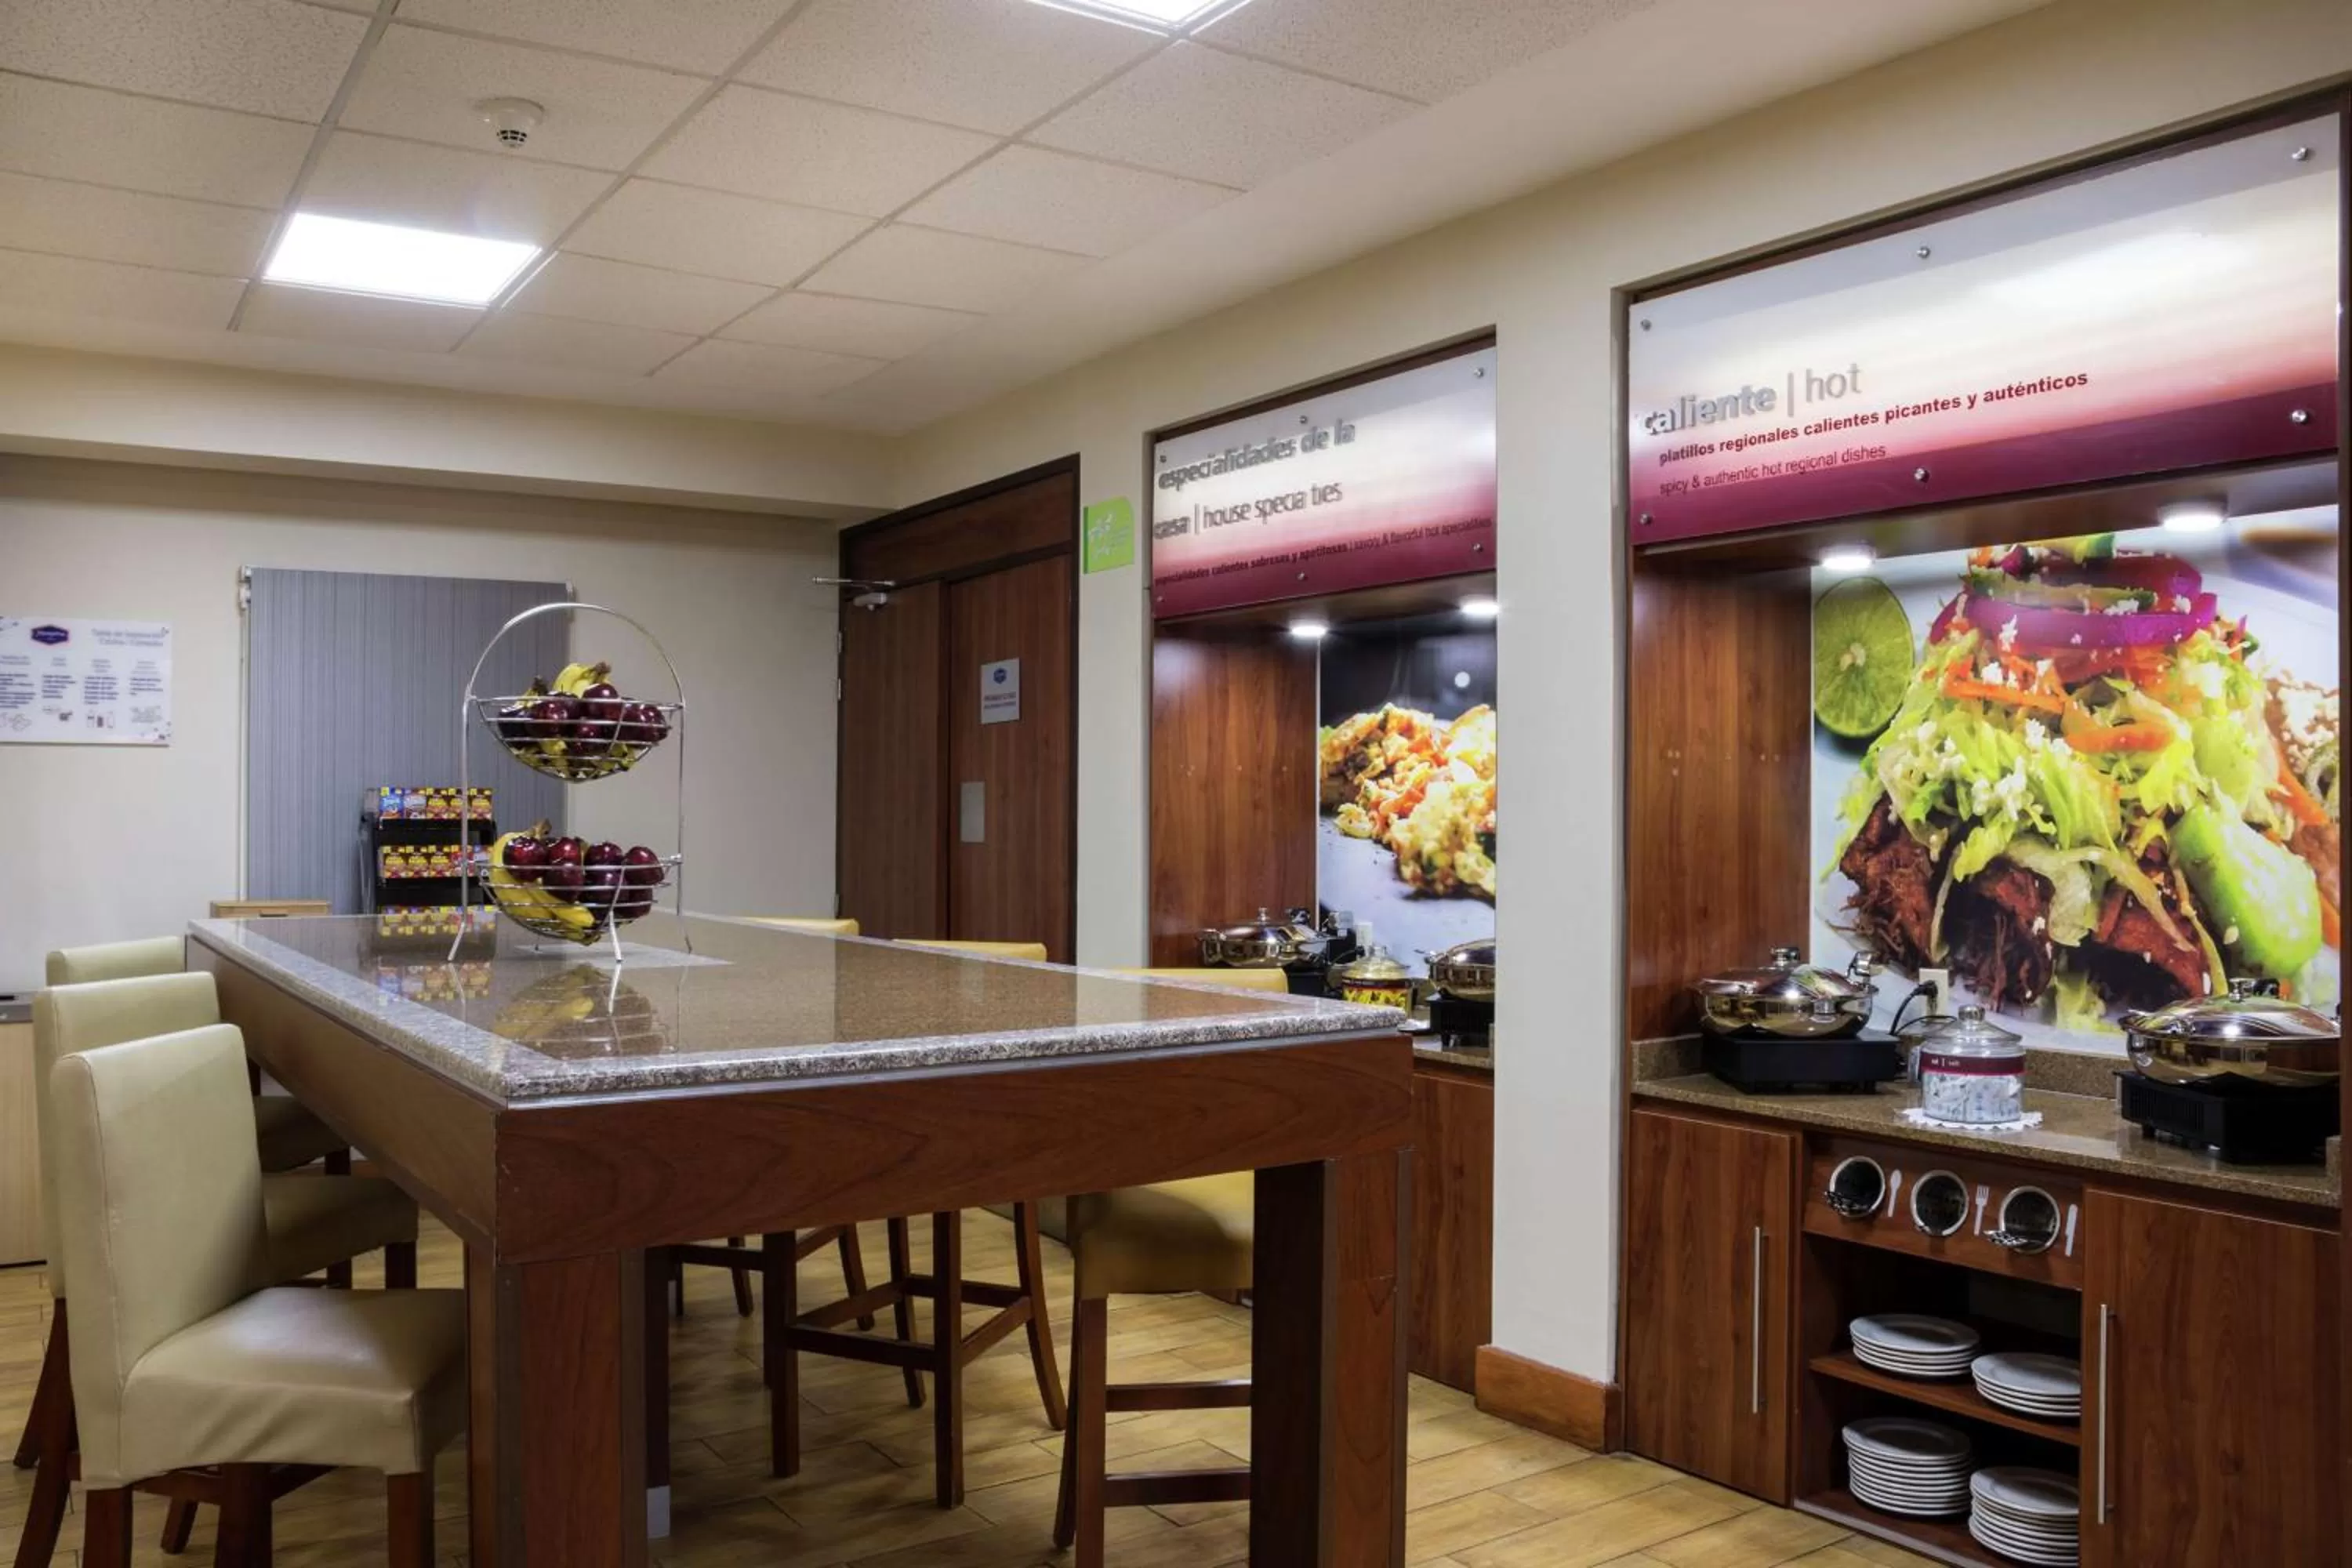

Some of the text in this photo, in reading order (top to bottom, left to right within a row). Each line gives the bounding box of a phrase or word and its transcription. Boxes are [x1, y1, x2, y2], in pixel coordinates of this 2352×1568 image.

[1644, 385, 1777, 437] caliente
[1806, 362, 1862, 403] hot
[1659, 372, 2089, 466] platillos regionales calientes picantes y auténticos
[1158, 418, 1356, 492] especialidades de la
[1659, 445, 1887, 496] spicy & authentic hot regional dishes
[1153, 515, 1190, 539] casa
[1203, 502, 1252, 530] house
